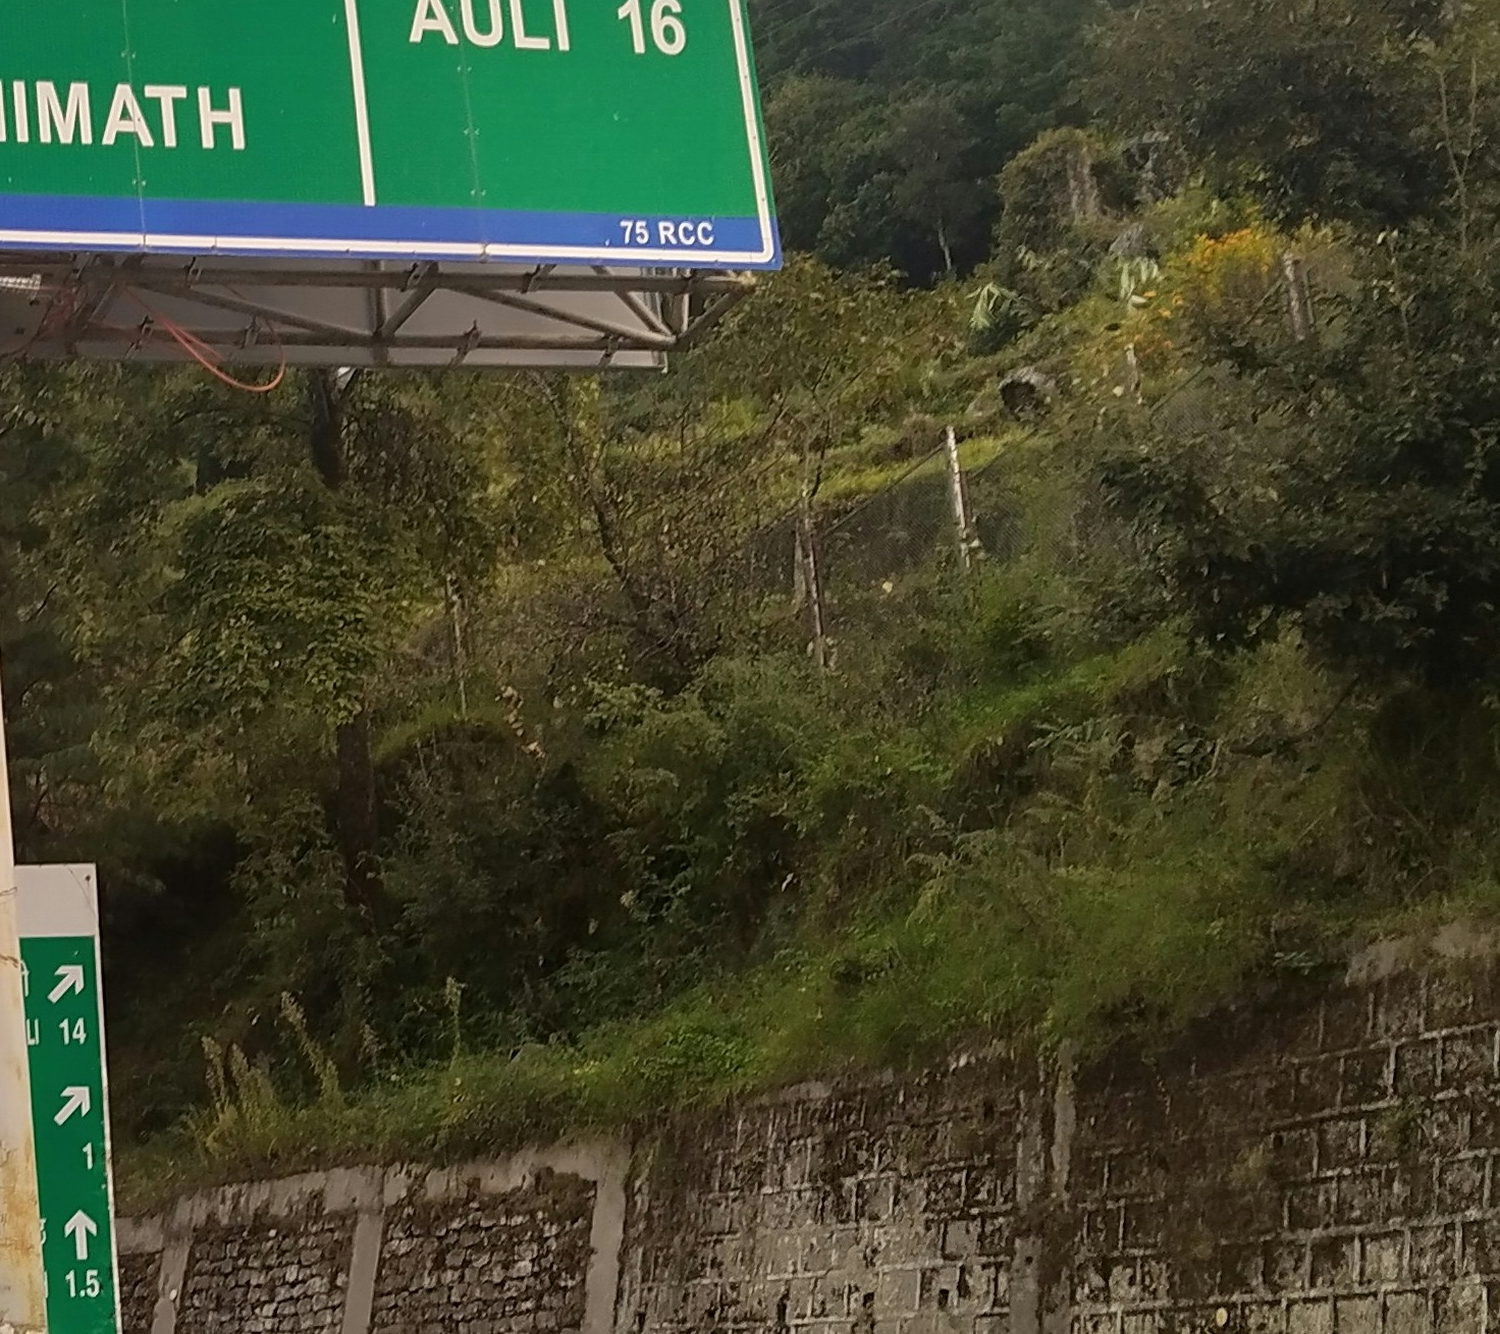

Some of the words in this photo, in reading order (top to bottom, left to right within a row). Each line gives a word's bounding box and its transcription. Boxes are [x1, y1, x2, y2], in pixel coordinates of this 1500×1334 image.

[619, 219, 652, 246] 75
[658, 220, 714, 246] RCC
[59, 1018, 86, 1045] 14
[83, 1144, 94, 1170] 1
[65, 1269, 100, 1298] 1.5
